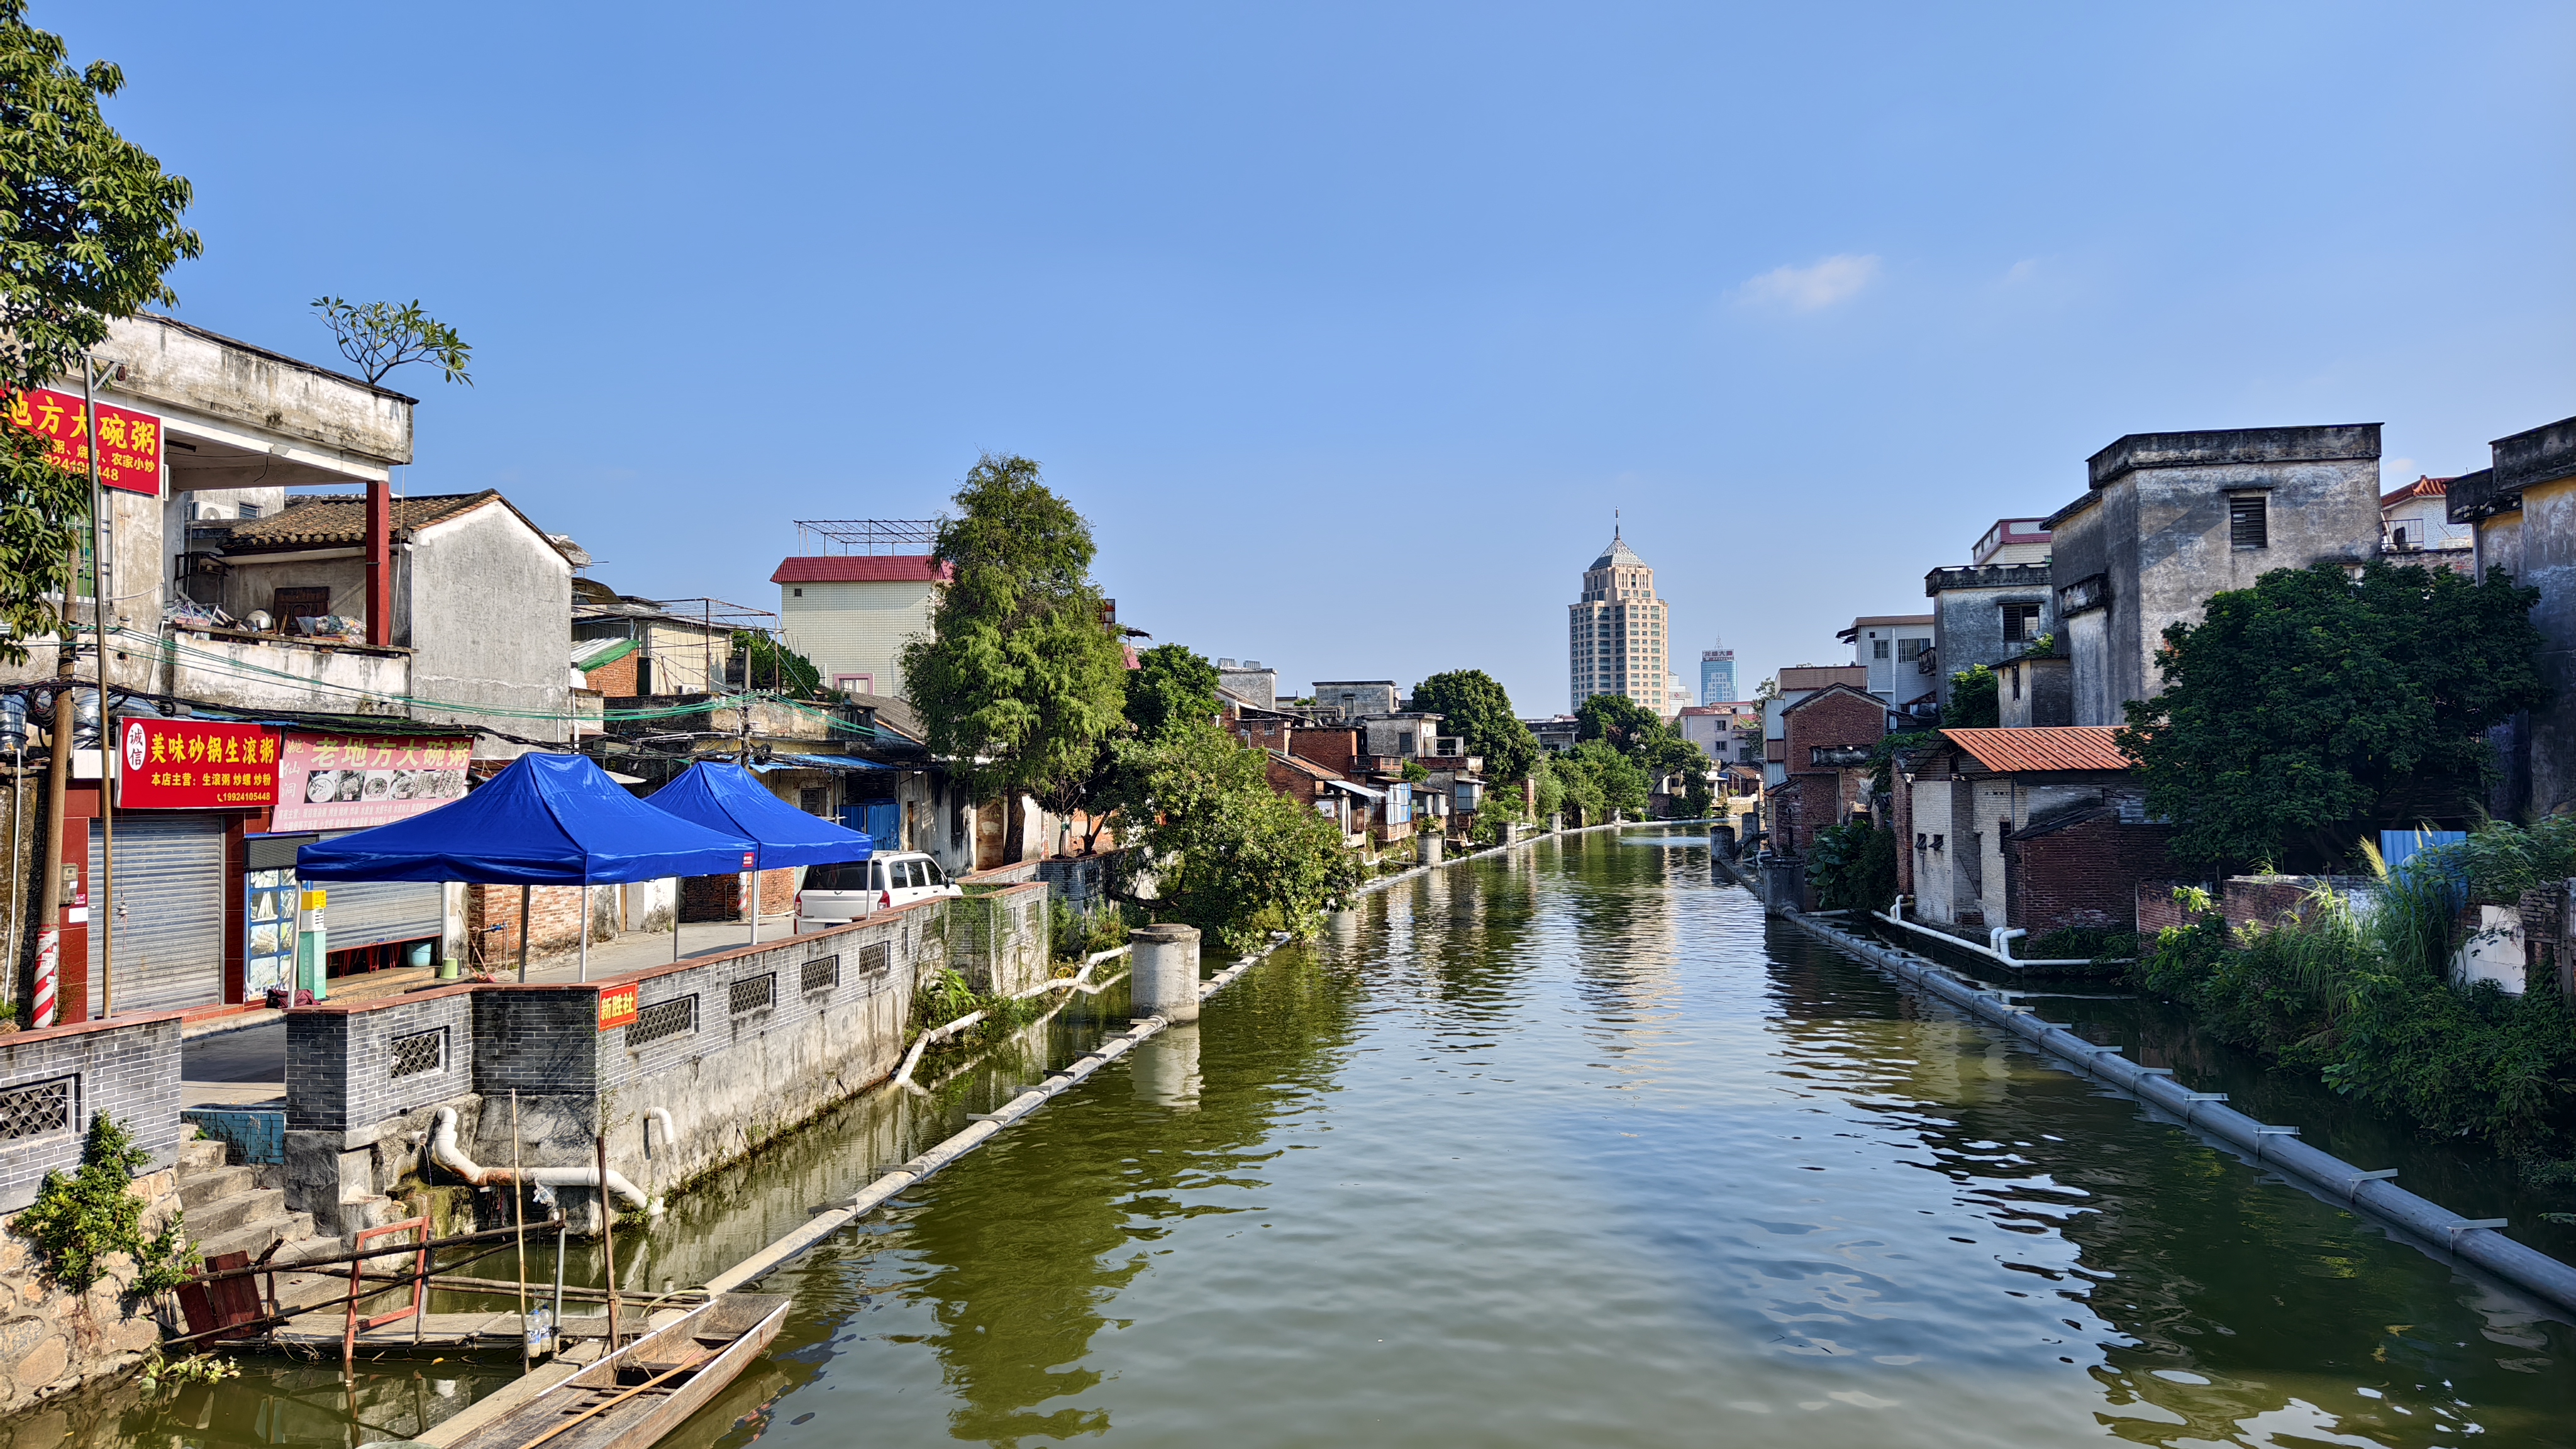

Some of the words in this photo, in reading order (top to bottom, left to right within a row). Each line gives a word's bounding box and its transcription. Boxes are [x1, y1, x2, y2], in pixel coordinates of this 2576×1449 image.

[129, 728, 143, 766] 诚信
[150, 731, 274, 765] 美味砂锅生滚粥
[310, 736, 471, 768] 老地方大碗粥
[202, 773, 231, 787] 生滚粥
[233, 773, 251, 786] 炒螺
[253, 773, 271, 786] 炒粉
[223, 792, 270, 801] 19924105448
[601, 991, 634, 1021] 新胜社
